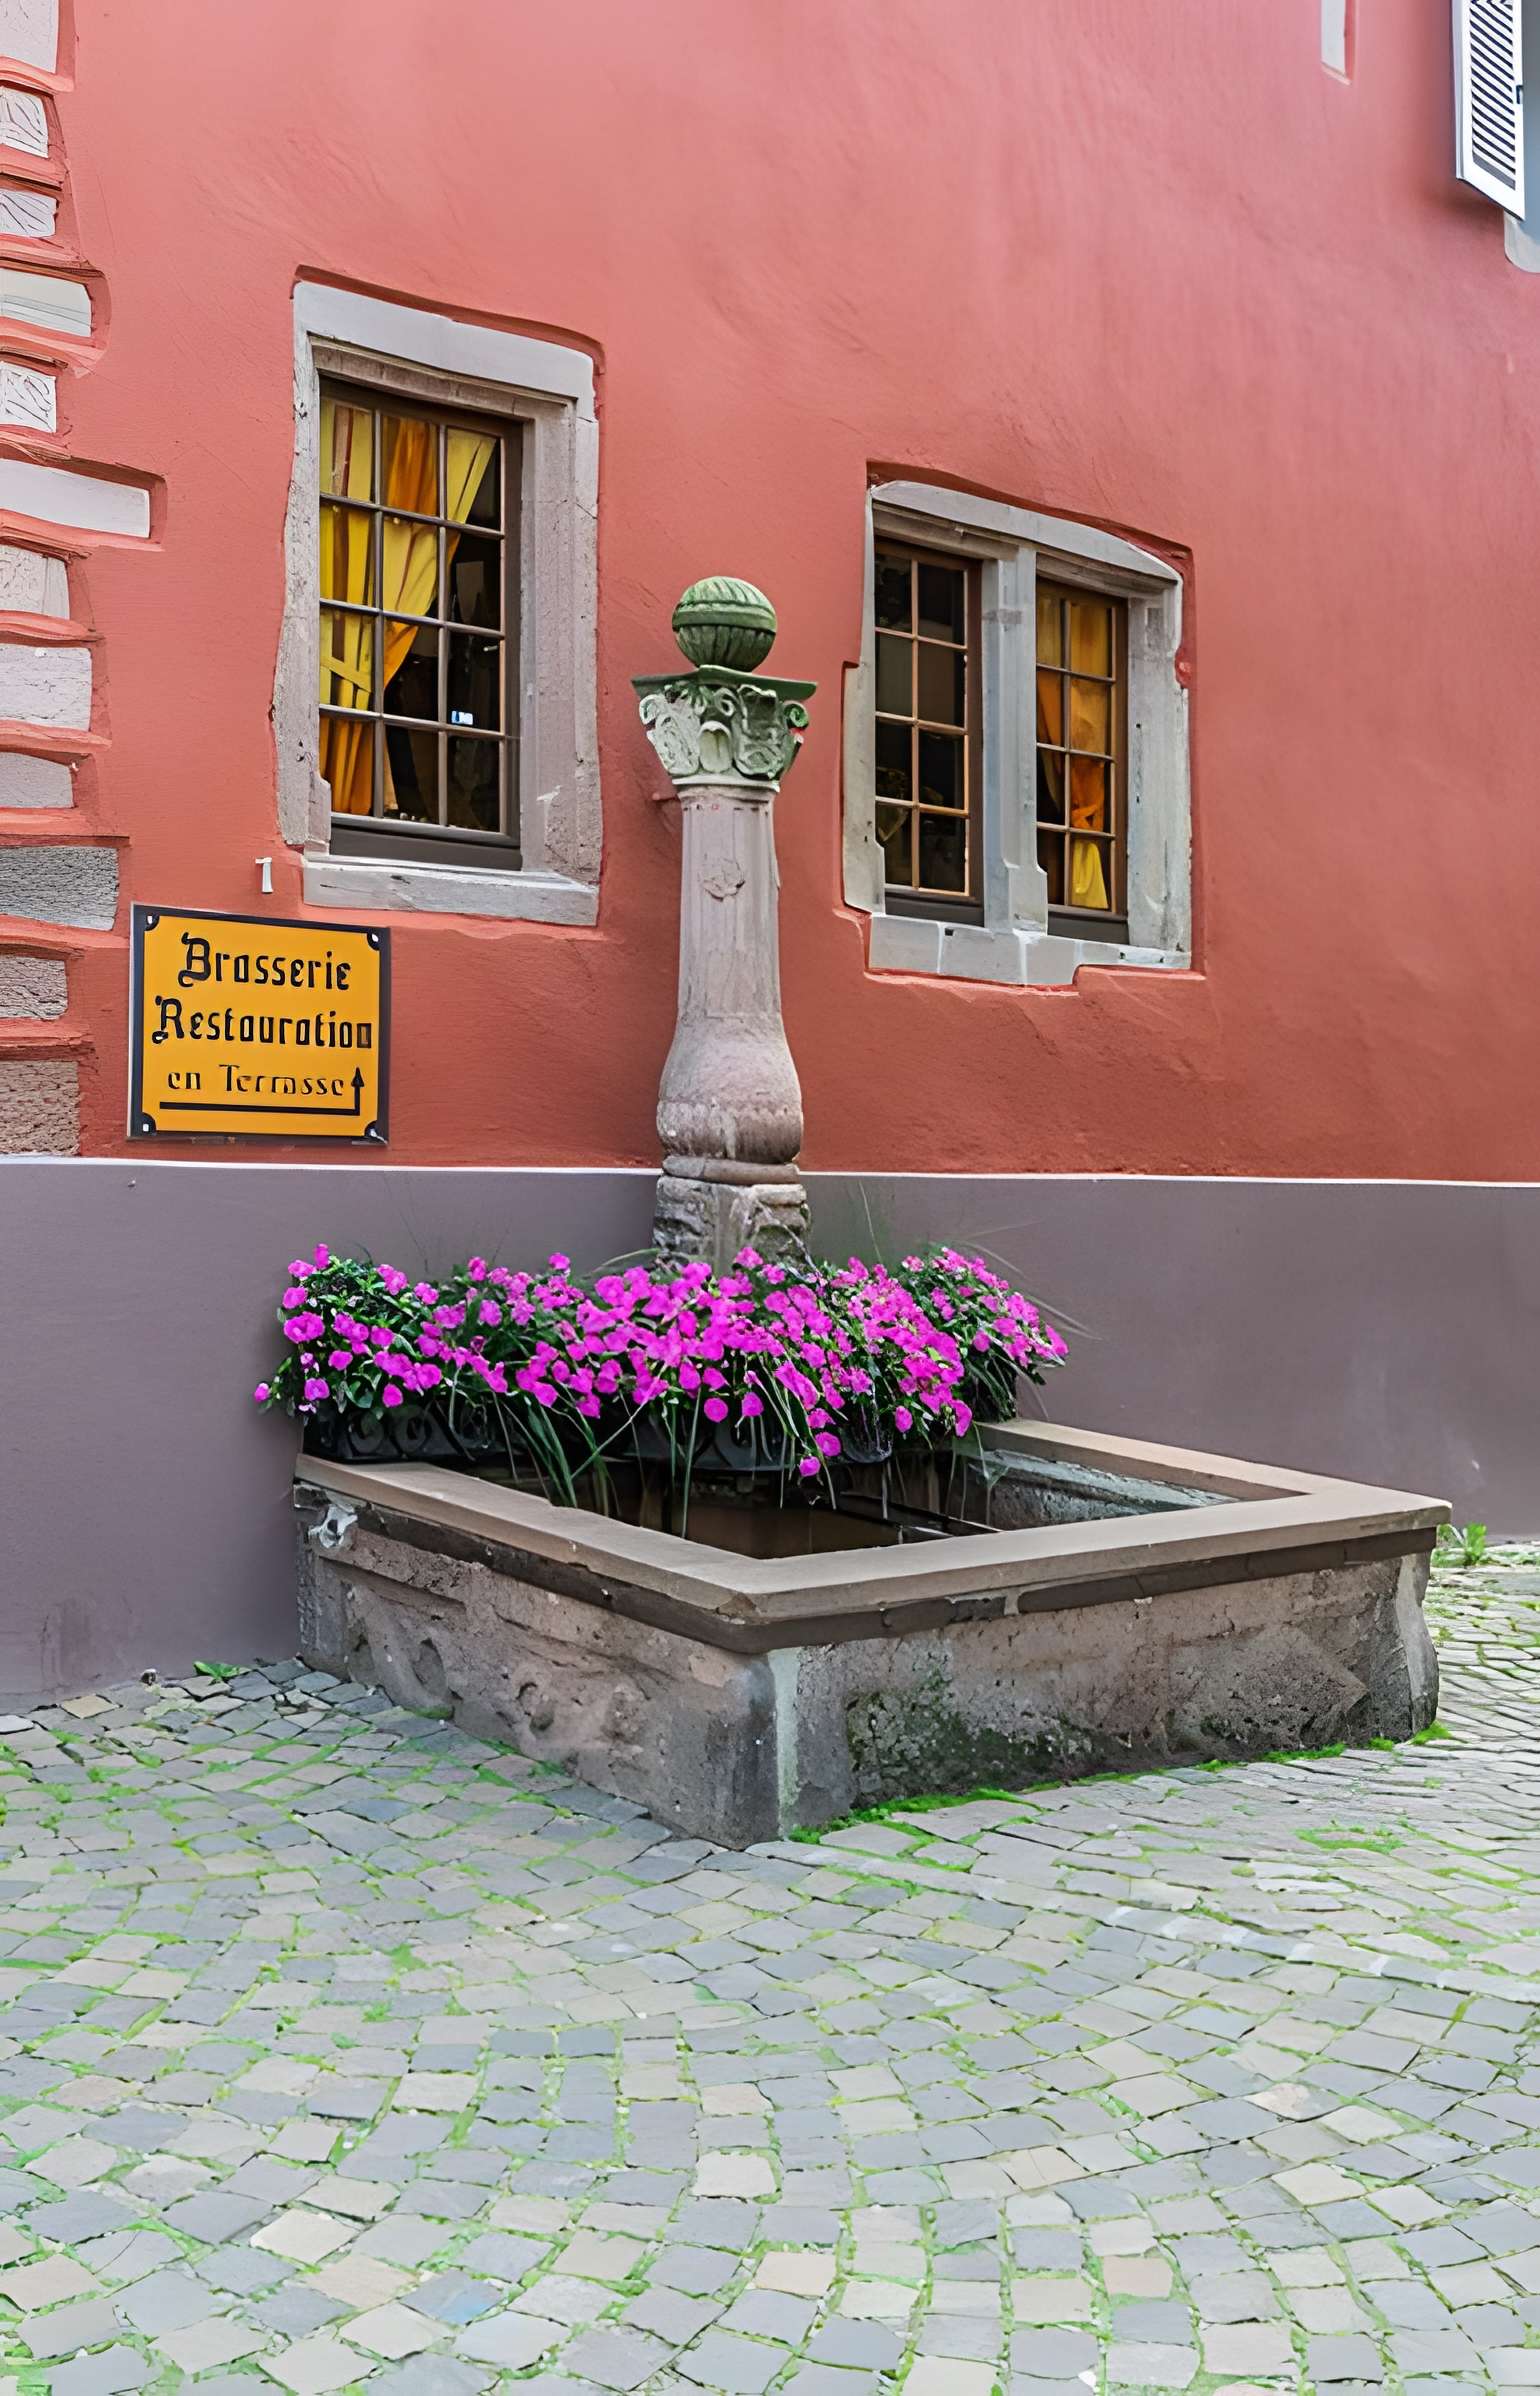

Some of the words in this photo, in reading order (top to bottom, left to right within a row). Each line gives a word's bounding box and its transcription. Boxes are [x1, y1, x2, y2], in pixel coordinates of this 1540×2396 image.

[178, 932, 350, 990] Brasserie
[152, 995, 372, 1049] Restauration
[168, 1071, 201, 1091] en
[219, 1064, 345, 1096] Terrasse
